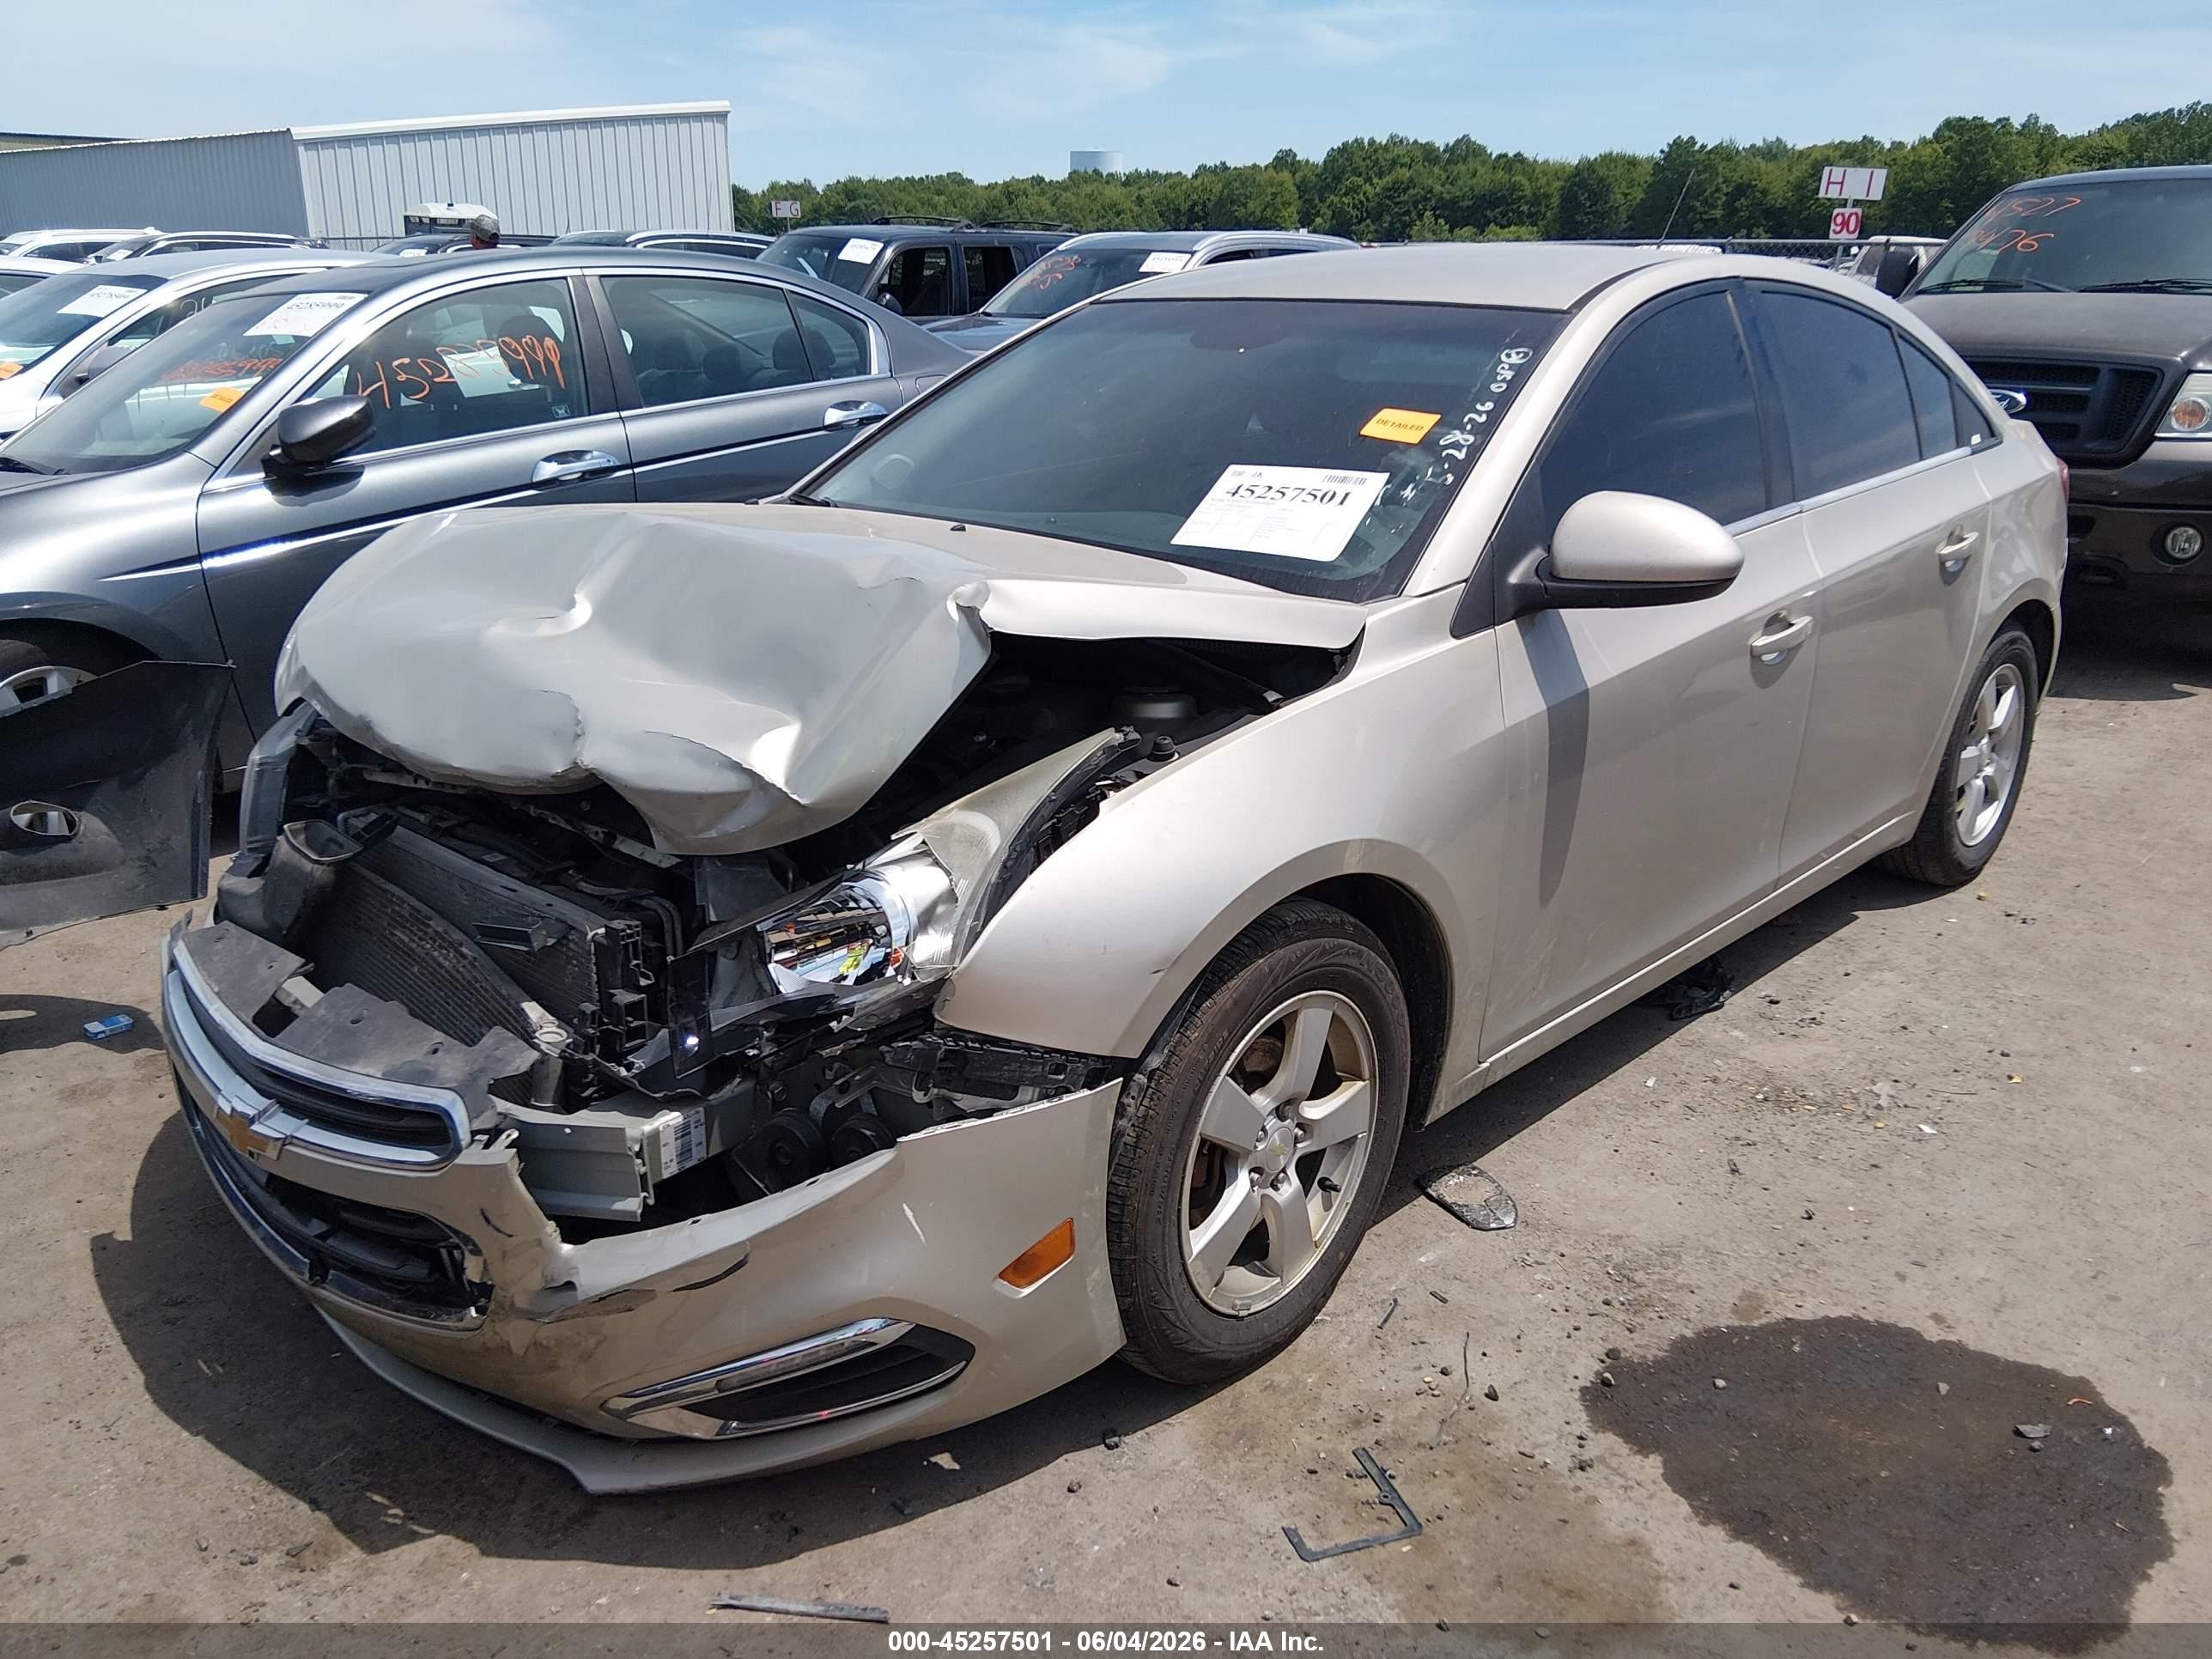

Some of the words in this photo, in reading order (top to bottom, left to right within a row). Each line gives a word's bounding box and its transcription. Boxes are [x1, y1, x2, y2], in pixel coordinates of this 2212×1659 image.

[1825, 168, 1847, 196] H
[775, 202, 782, 216] F
[790, 202, 799, 216] G
[1832, 211, 1861, 234] 90
[1376, 418, 1424, 431] DETAILED
[1225, 483, 1352, 507] 45257501
